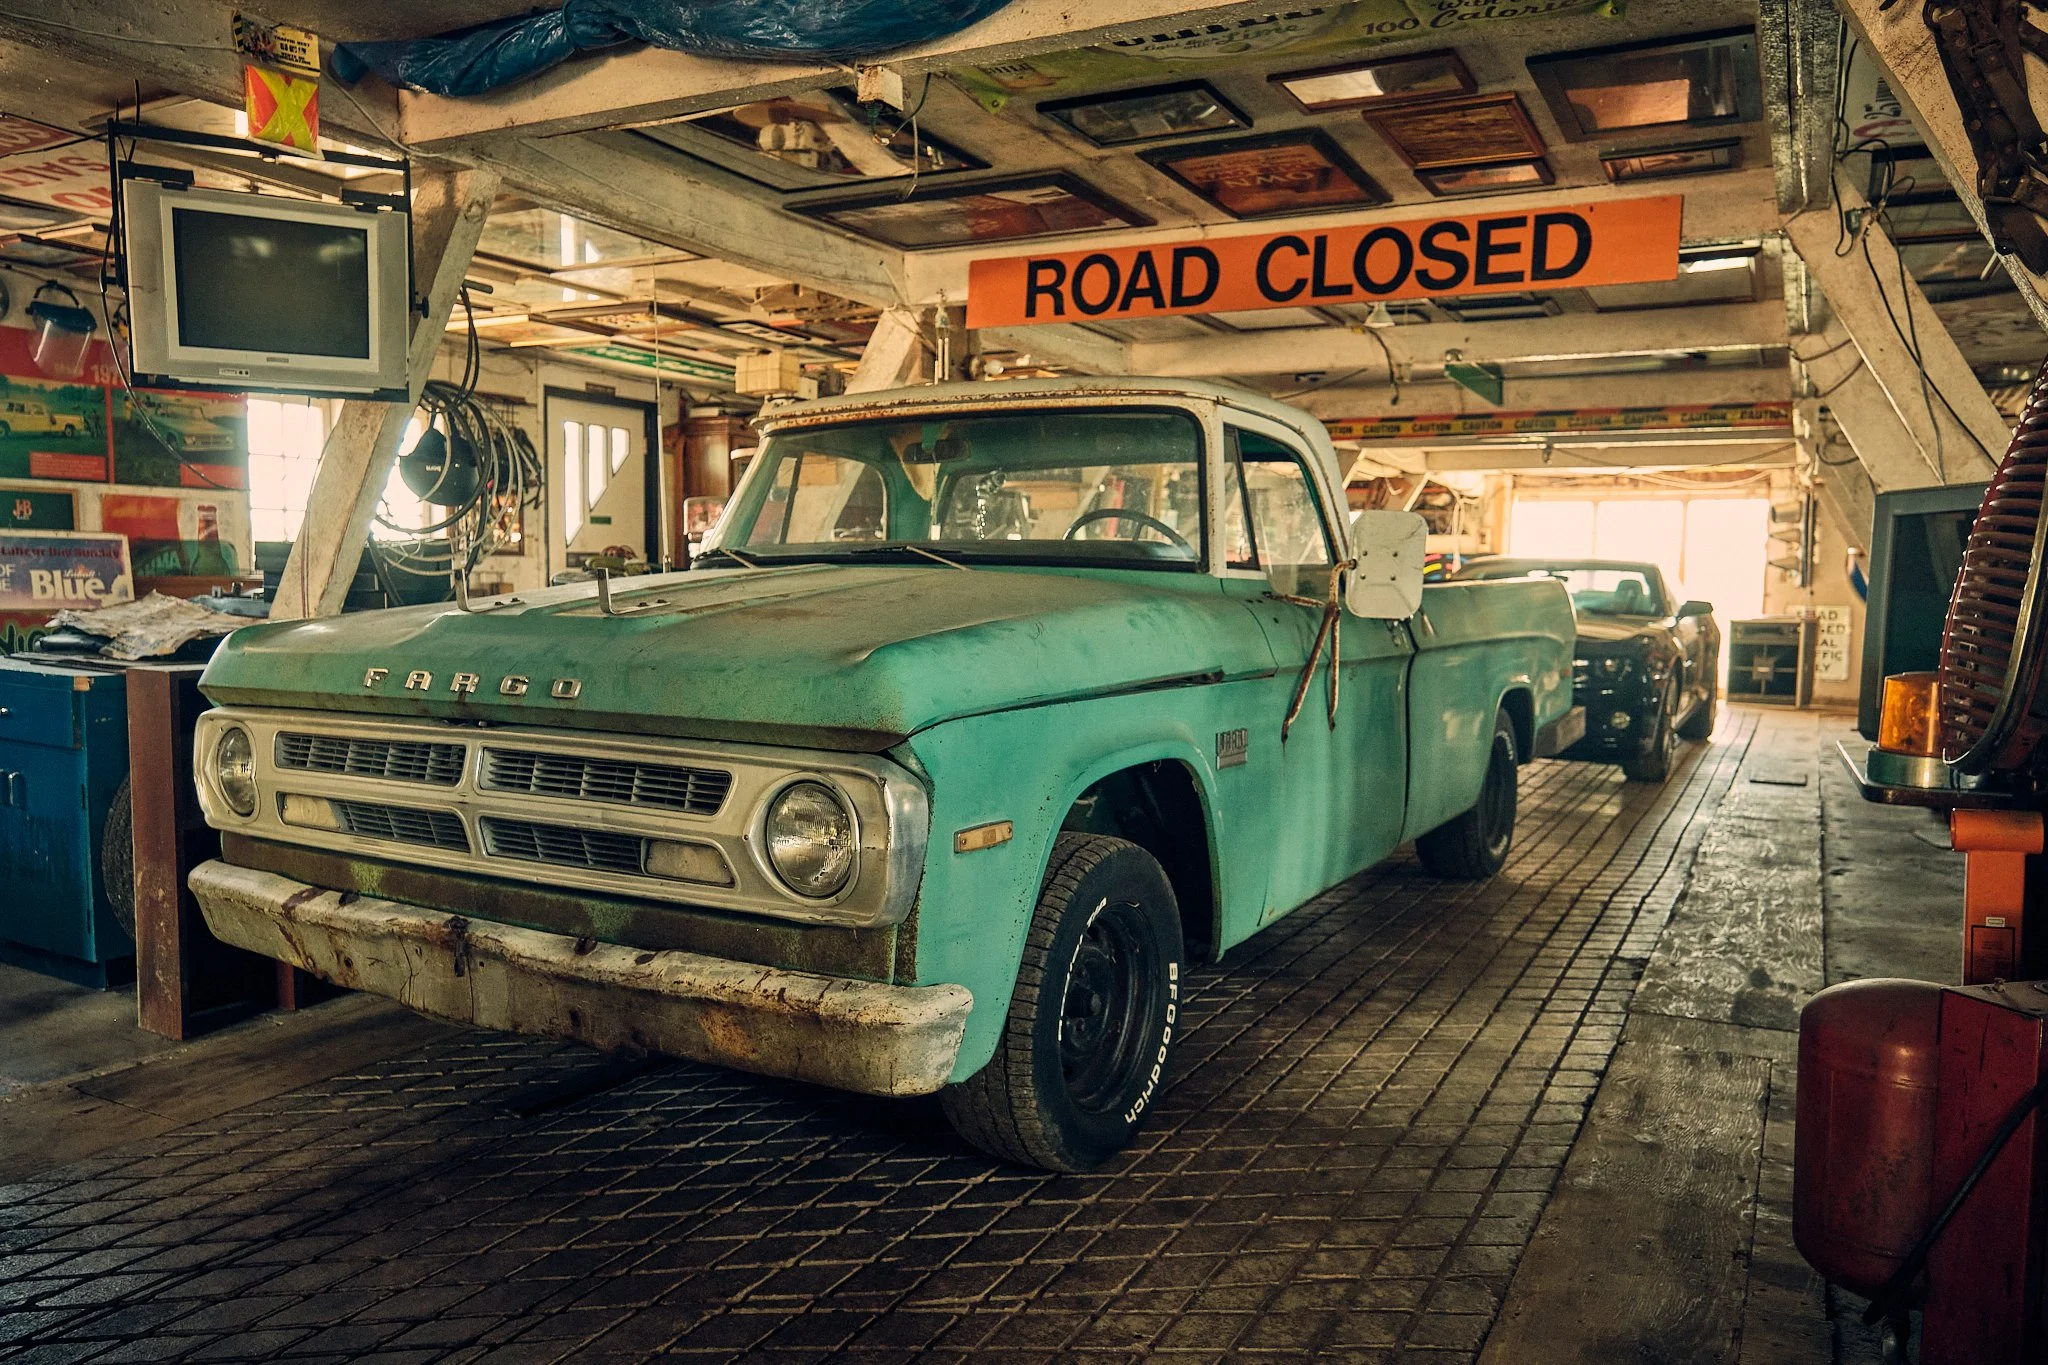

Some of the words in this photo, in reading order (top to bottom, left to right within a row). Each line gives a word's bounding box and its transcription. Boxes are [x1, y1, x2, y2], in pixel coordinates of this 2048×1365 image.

[1363, 18, 1420, 35] 100
[1025, 246, 1220, 318] ROAD
[1256, 212, 1593, 302] CLOSED
[1362, 424, 1400, 434] CAUTION
[1412, 422, 1451, 433] CAUTION
[1462, 420, 1503, 431] CAUTION
[1514, 418, 1556, 429] CAUTION
[30, 569, 106, 600] Blue
[363, 667, 582, 699] FARGO
